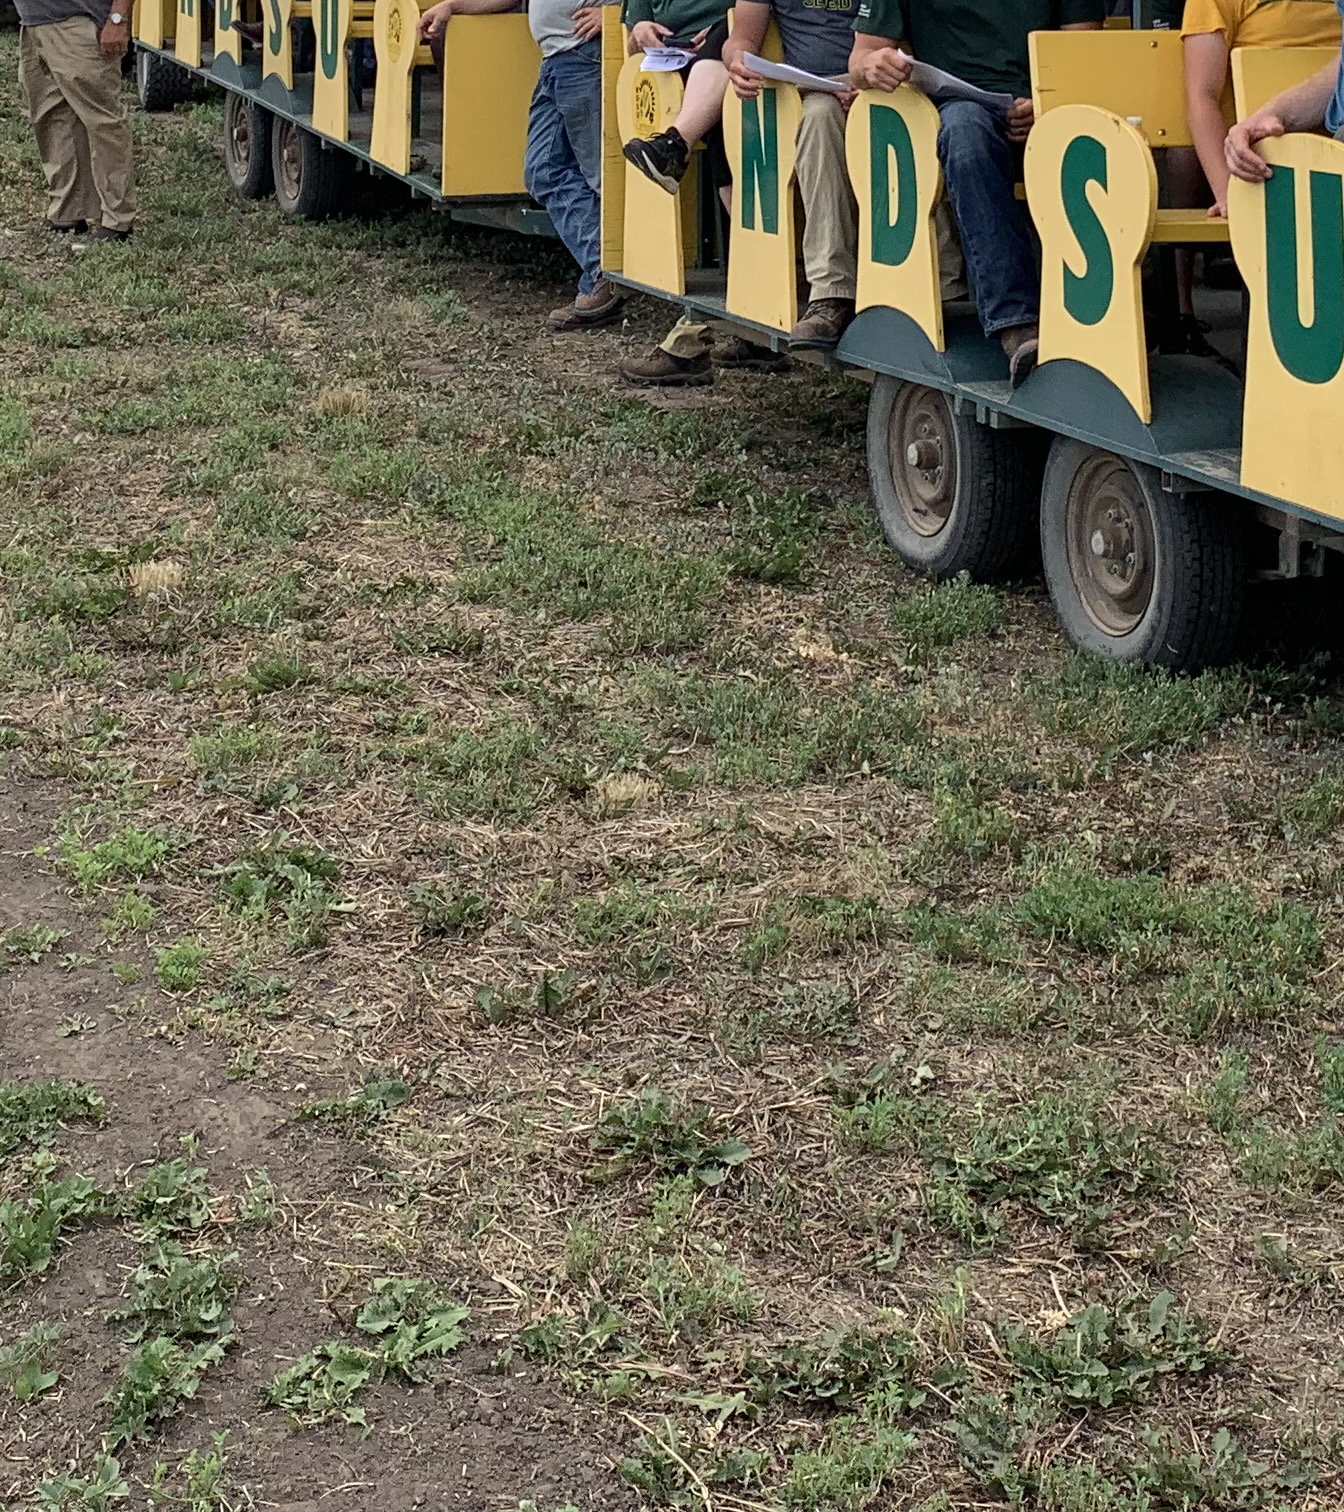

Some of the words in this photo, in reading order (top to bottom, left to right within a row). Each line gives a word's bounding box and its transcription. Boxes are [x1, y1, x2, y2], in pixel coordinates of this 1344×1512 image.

[741, 87, 778, 235] N
[869, 103, 918, 266] D
[1060, 135, 1113, 326] S
